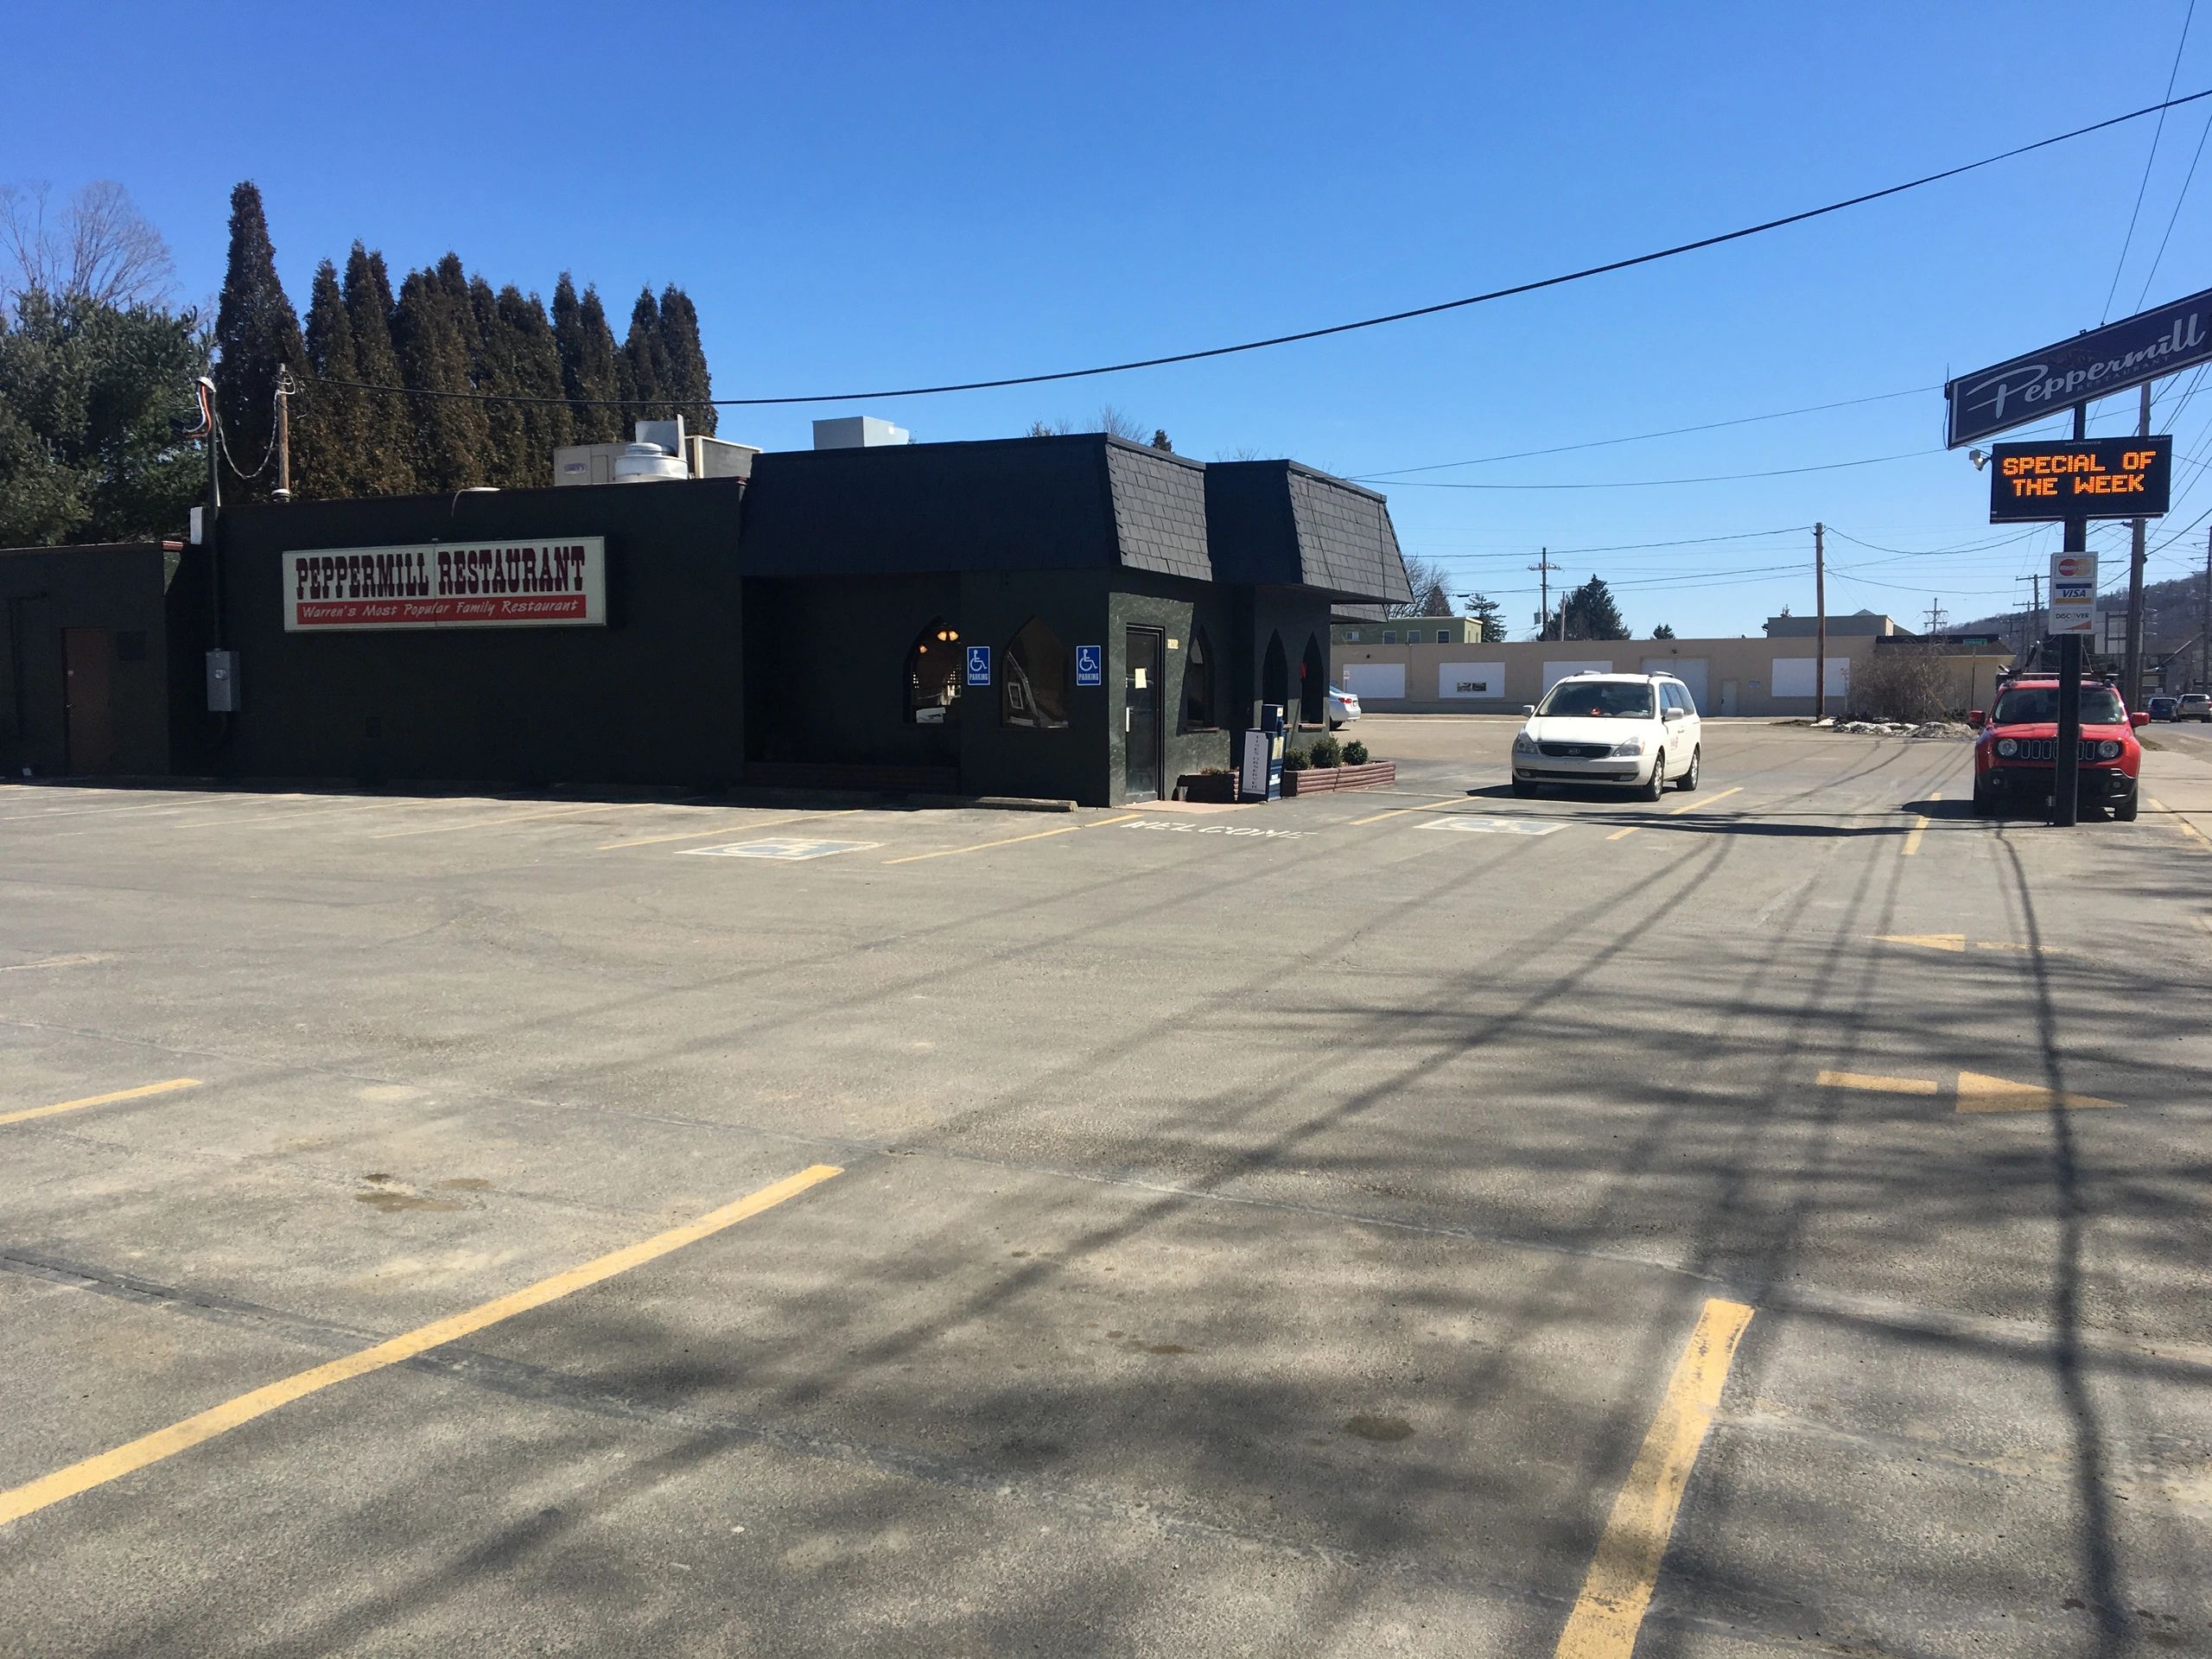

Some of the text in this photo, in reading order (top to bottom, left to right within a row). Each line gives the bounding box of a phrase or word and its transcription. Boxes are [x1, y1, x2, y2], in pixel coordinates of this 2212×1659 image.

[1966, 313, 2206, 419] Peppermill
[2077, 355, 2171, 391] RESTAURANT
[2003, 451, 2157, 475] SPECIAL OF
[2012, 474, 2145, 496] THE WEEK
[296, 545, 586, 600] PEPPERMILL RESTAURANT
[2063, 589, 2086, 598] VISA
[303, 600, 579, 618] Warren's Most Popular Family Restaurant
[1120, 821, 1319, 839] WELCOME
